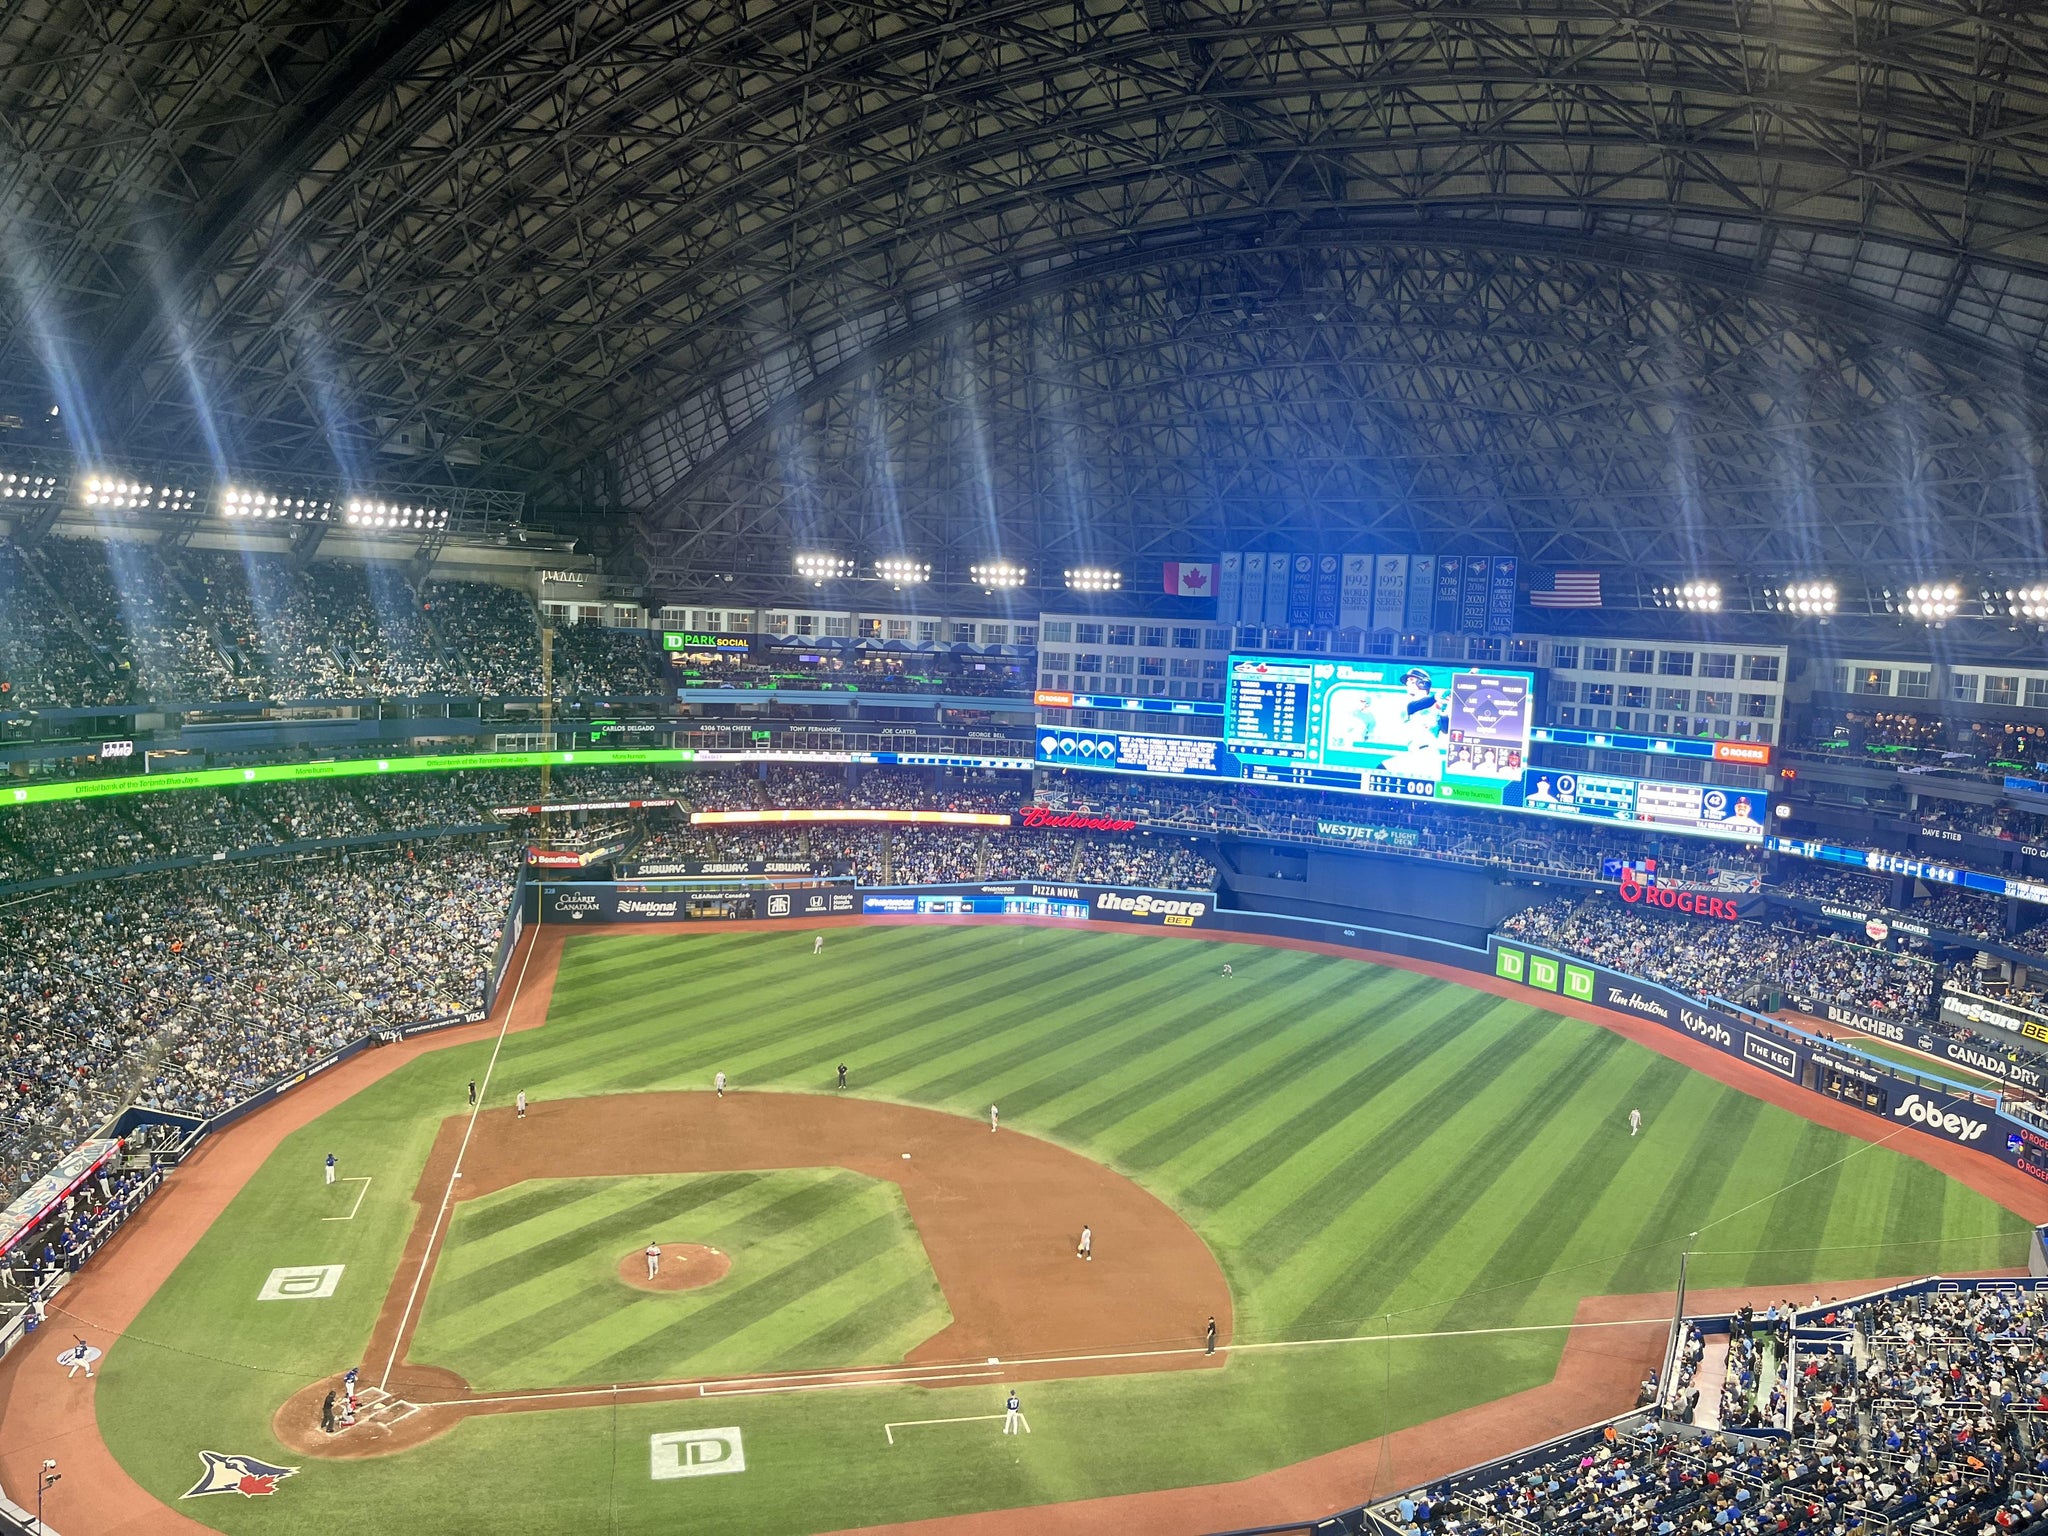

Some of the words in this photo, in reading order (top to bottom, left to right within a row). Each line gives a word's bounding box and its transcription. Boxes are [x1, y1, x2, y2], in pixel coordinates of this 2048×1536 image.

[1345, 575, 1368, 587] 1992
[1379, 575, 1403, 587] 1993
[1440, 576, 1457, 585] 2016
[1494, 577, 1513, 587] 2025
[1343, 588, 1368, 597] WORLD
[1377, 589, 1403, 597] WORLD
[1439, 587, 1457, 596] ALDS
[1467, 582, 1485, 592] 2016
[1342, 597, 1368, 605] SERIES
[1375, 598, 1402, 606] SERIES
[1466, 595, 1485, 604] 2020
[1493, 600, 1512, 608] EAST
[1465, 607, 1484, 616] 2022
[1492, 617, 1511, 625] ALCS
[665, 635, 683, 648] TD
[685, 635, 717, 645] PARK
[716, 638, 749, 647] SOCIAL
[1045, 695, 1069, 703] ROGERS
[789, 725, 806, 733] TONY
[1730, 749, 1764, 760] ROGERS
[75, 784, 100, 794] Official
[100, 782, 118, 792] bank
[118, 781, 126, 790] of
[127, 780, 139, 789] the
[139, 778, 165, 788] Toronto
[166, 777, 181, 786] Blue
[1453, 788, 1470, 797] More
[1019, 806, 1137, 831] Budweiser
[1318, 822, 1374, 840] WESTJET
[1390, 831, 1417, 840] FLIGHT
[1922, 828, 1940, 838] DAVE
[1942, 830, 1962, 841] STIEB
[2021, 846, 2038, 856] CITO
[538, 855, 579, 864] BeautiTone
[638, 864, 686, 875] SUBWAY
[701, 863, 749, 873] SUBWAY
[764, 863, 811, 872] SUBWAY
[560, 893, 596, 903] CLEARLY
[1033, 885, 1055, 896] PIZZA
[1057, 887, 1079, 899] NOVA
[555, 902, 600, 911] CANADIAN
[630, 900, 678, 912] National
[1097, 893, 1206, 917] theScore
[1646, 886, 1737, 921] ROGERS
[1167, 917, 1191, 925] BET
[1821, 905, 1852, 918] CANADA
[1853, 911, 1868, 921] DRY
[1891, 920, 1929, 935] BLEACHERS
[1343, 929, 1355, 937] 400
[1501, 954, 1522, 976] TD
[1533, 963, 1555, 985] TD
[1568, 973, 1591, 995] TD
[1608, 987, 1628, 1006] Tim
[1628, 992, 1668, 1019] Hortons
[1943, 996, 2021, 1032] theScore
[405, 1024, 431, 1034] everywhere
[430, 1022, 439, 1030] you
[464, 1010, 486, 1023] VISA
[1680, 1008, 1732, 1047] Kubota
[1827, 1006, 1904, 1042] BLEACHERS
[1947, 1044, 2008, 1076] CANADA
[2010, 1065, 2041, 1088] DRY
[1750, 1042, 1769, 1059] THE
[1771, 1051, 1790, 1067] KEG
[1811, 1052, 1833, 1067] Active
[1894, 1094, 1988, 1141] Sobeys
[278, 1268, 329, 1295] TD
[661, 1438, 732, 1467] TD
